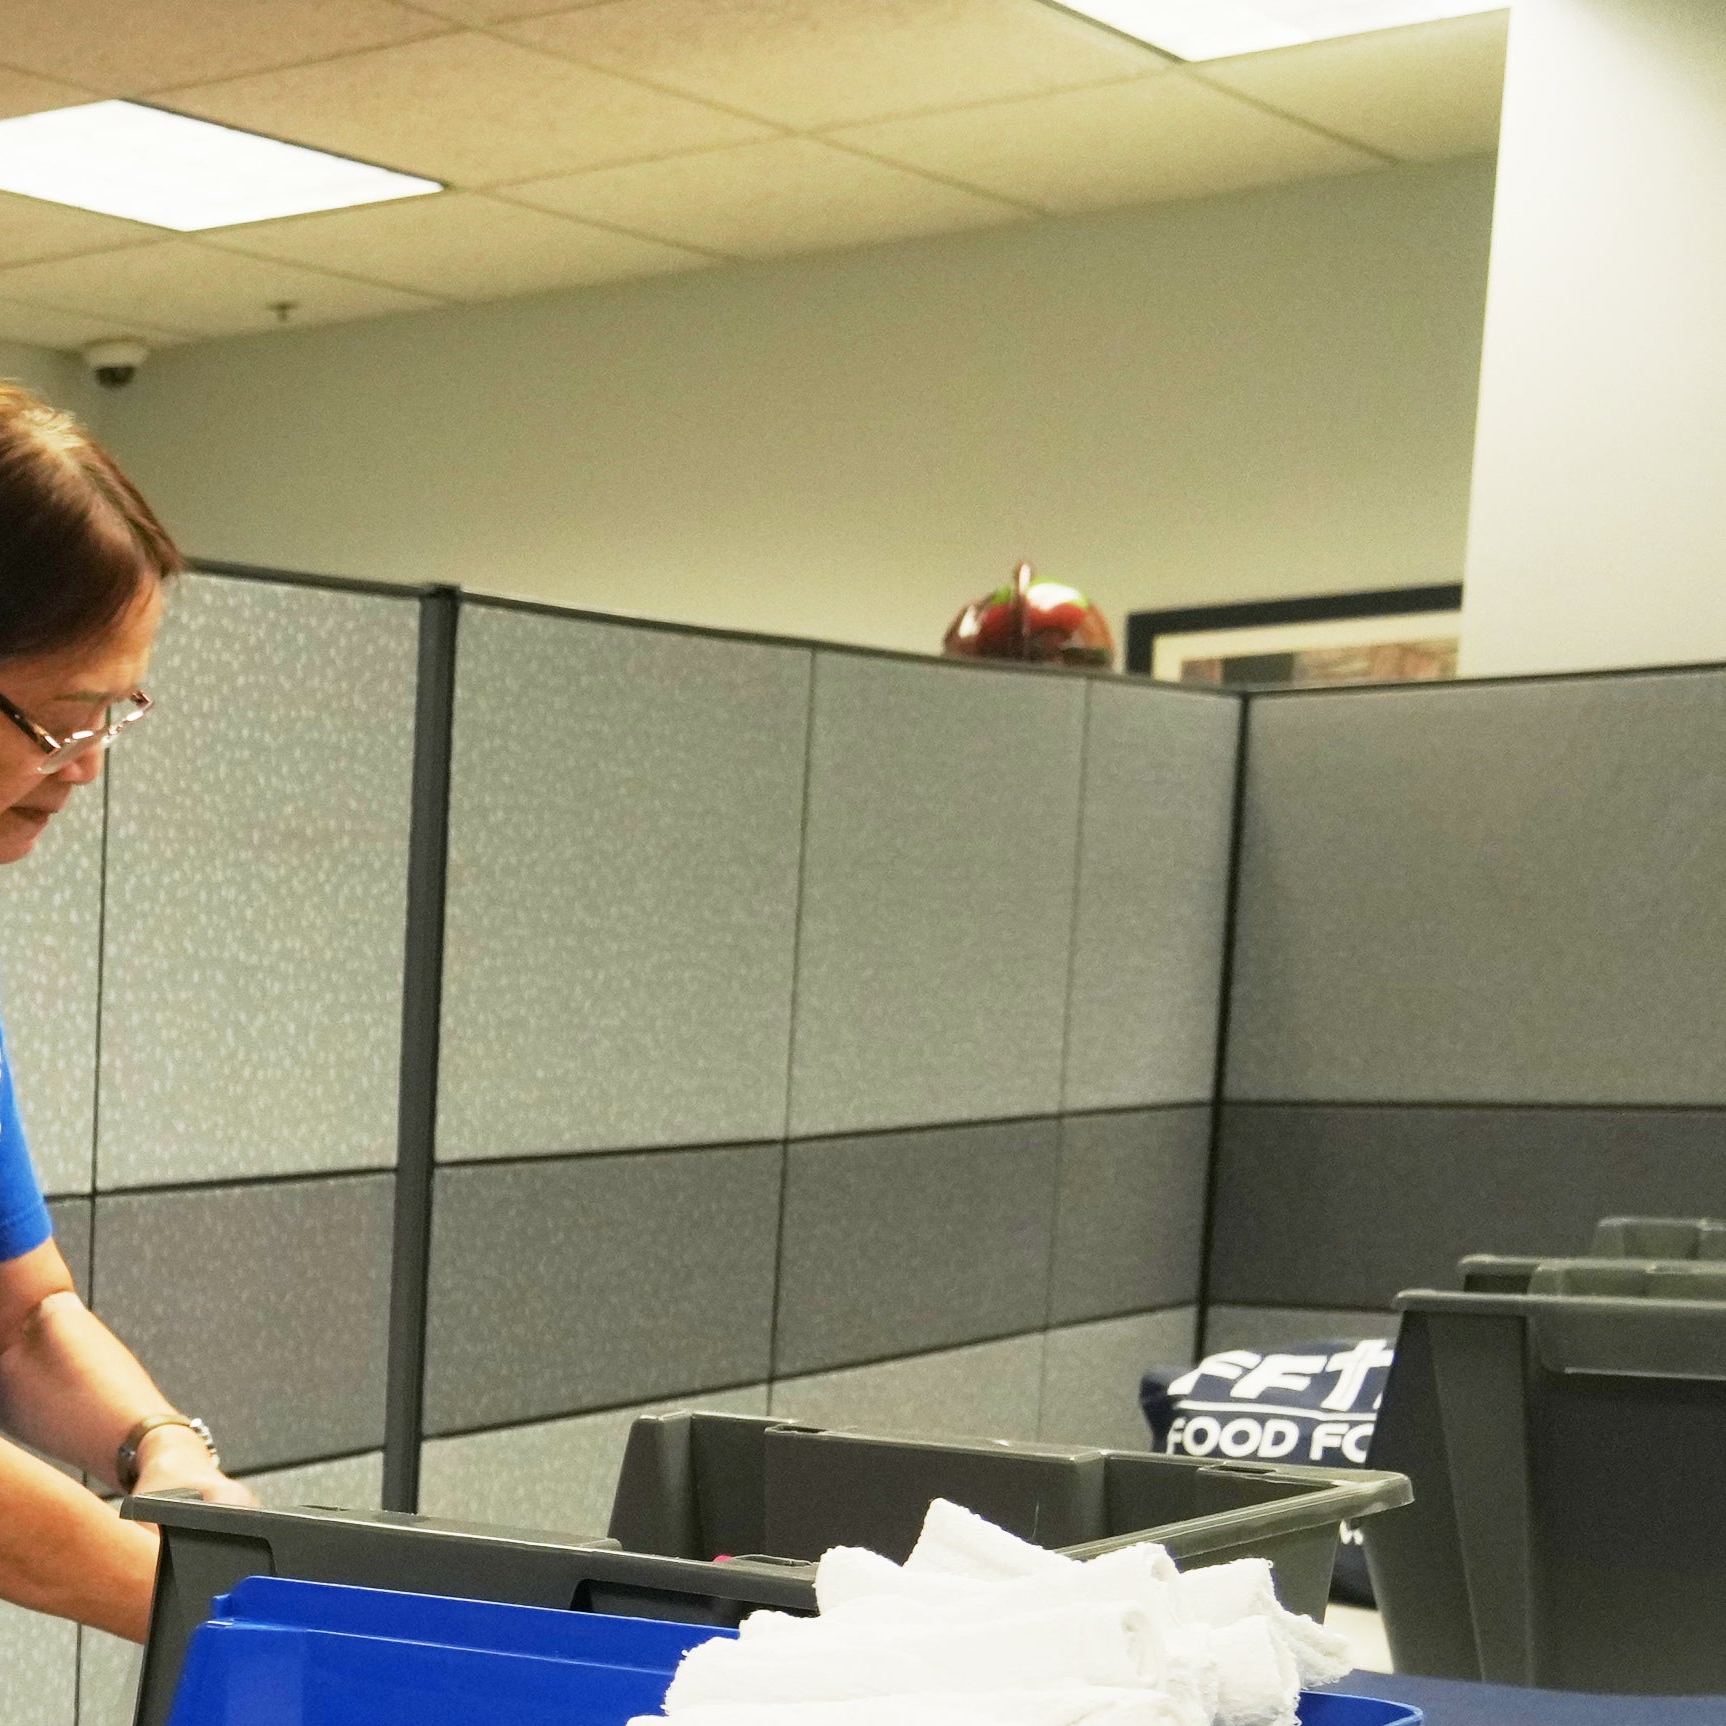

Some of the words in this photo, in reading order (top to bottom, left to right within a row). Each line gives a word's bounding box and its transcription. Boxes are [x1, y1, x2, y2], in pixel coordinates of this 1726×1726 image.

[1167, 1339, 1396, 1413] FFT
[1167, 1416, 1299, 1458] FOOD
[1310, 1423, 1375, 1464] FO
